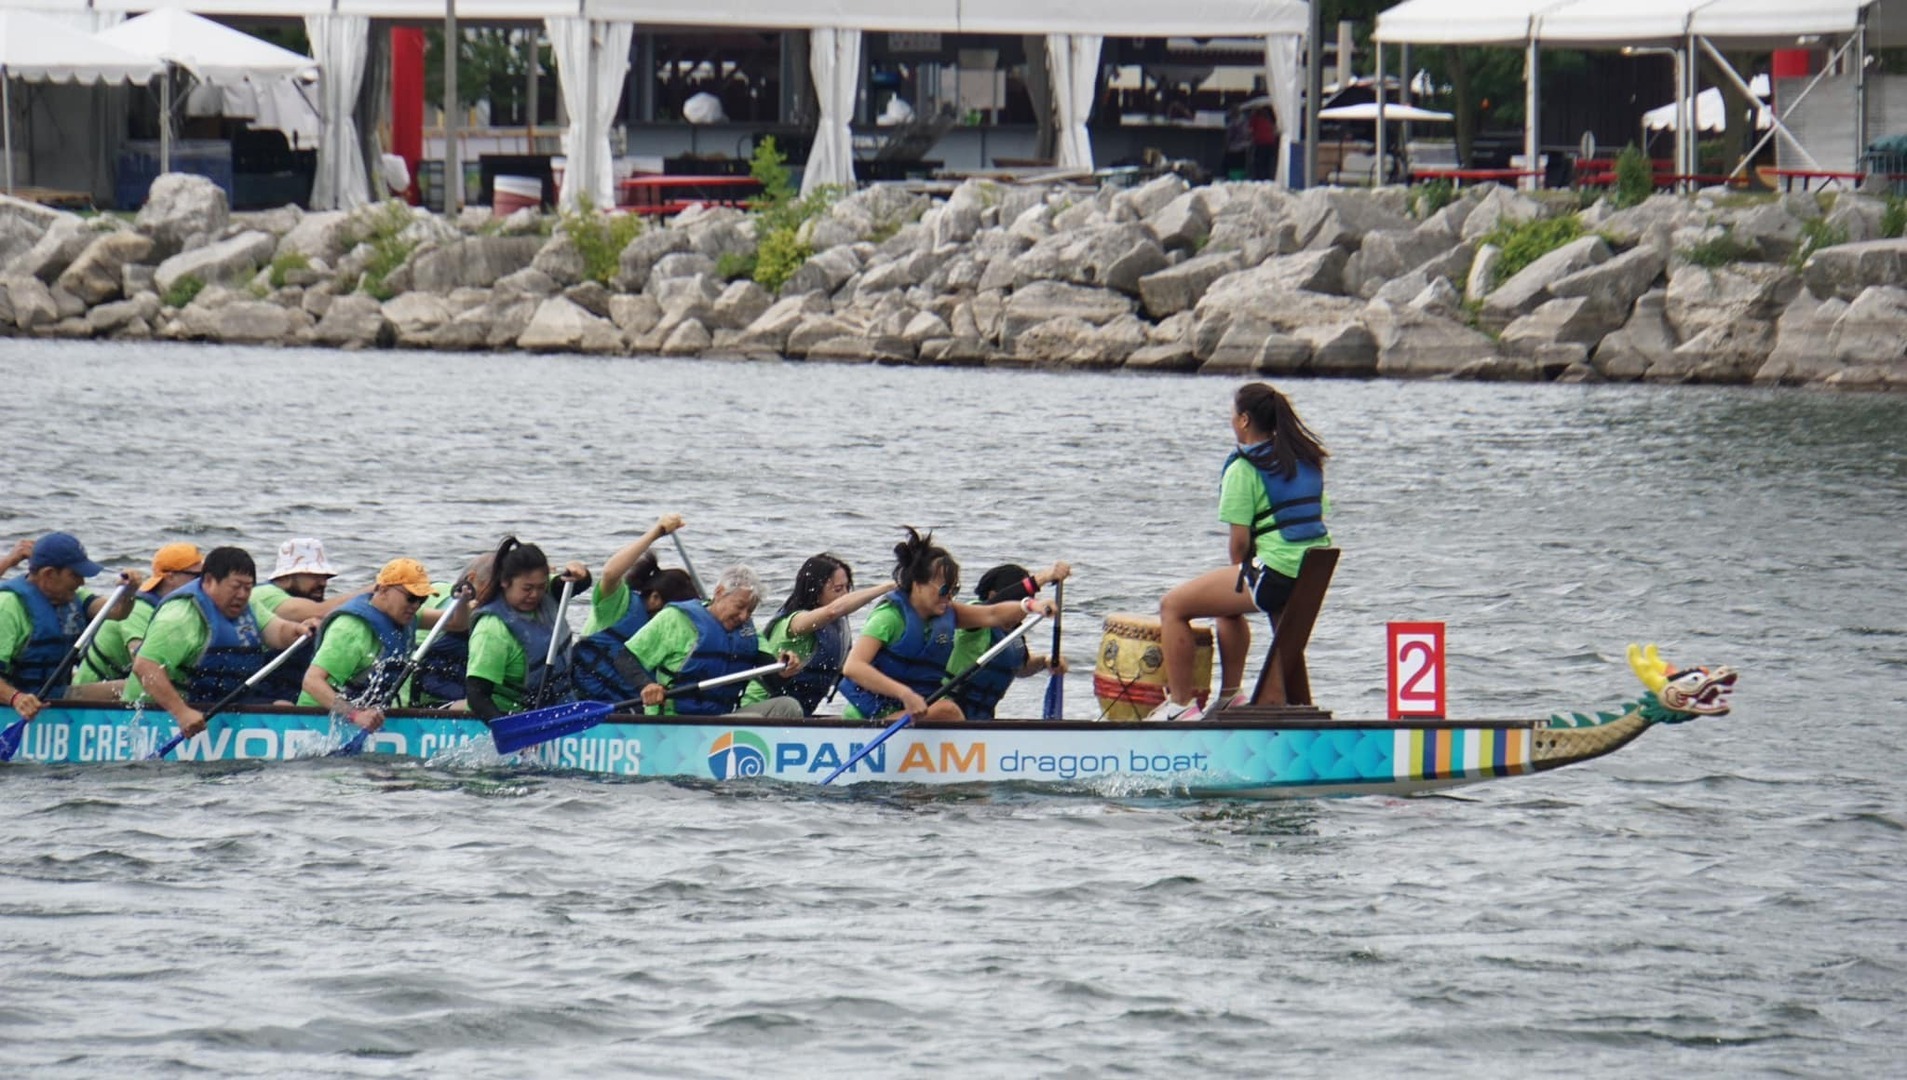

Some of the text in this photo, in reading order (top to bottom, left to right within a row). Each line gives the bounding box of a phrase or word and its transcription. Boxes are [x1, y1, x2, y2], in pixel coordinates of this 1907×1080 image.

[1399, 640, 1437, 701] 2
[5, 722, 641, 775] LUB CREW WOD CHNSHIPS
[775, 741, 1208, 780] PAN AM dragon boat
